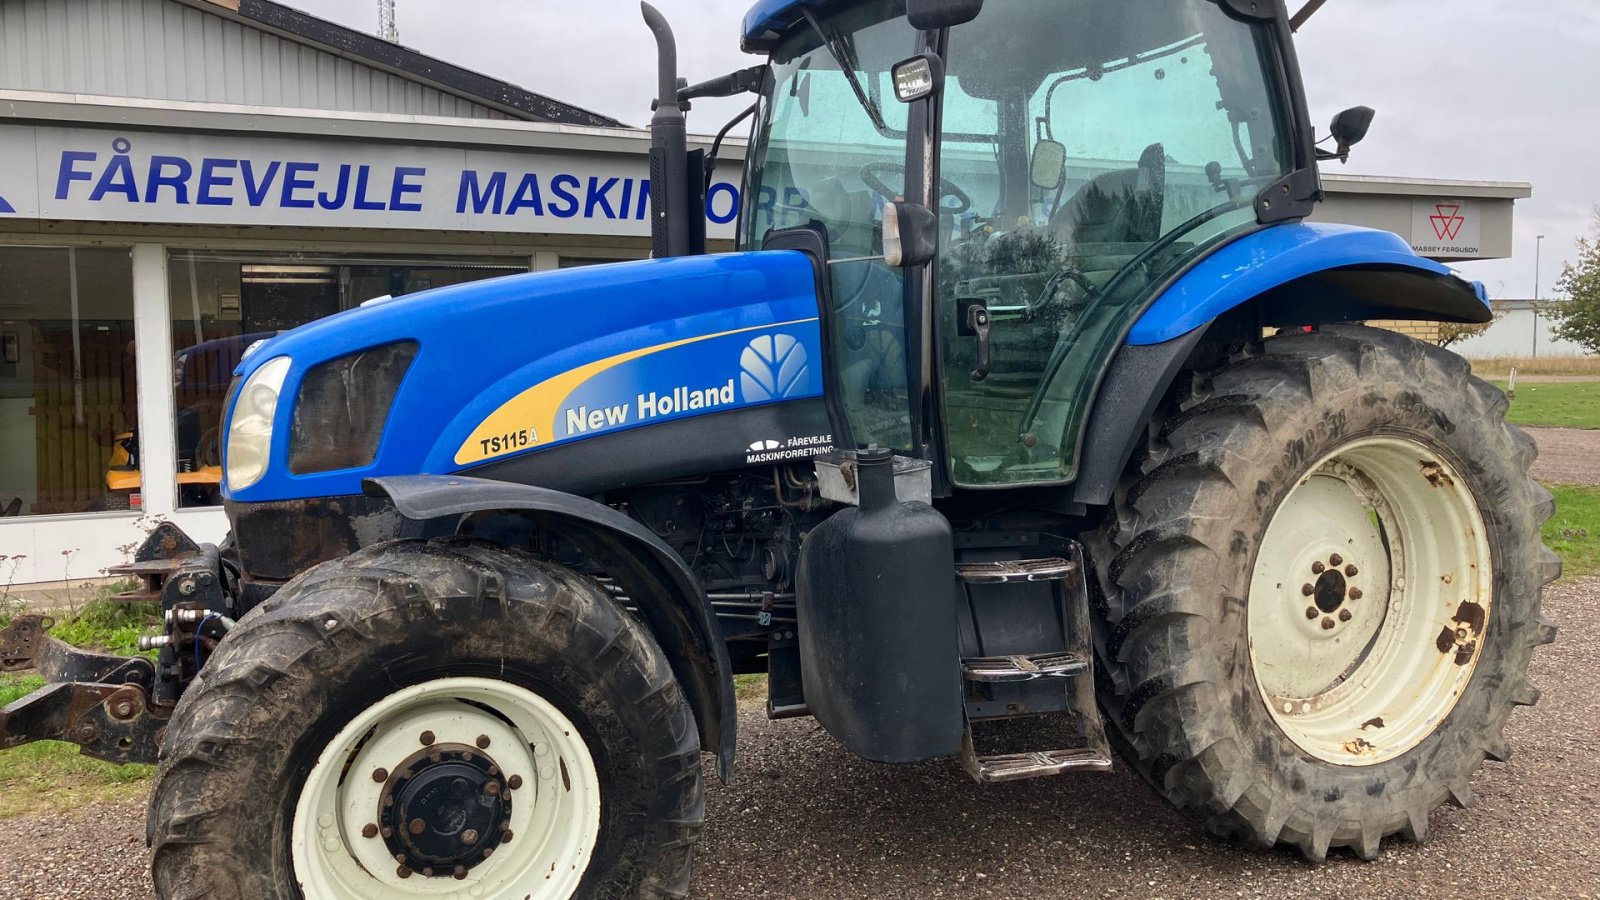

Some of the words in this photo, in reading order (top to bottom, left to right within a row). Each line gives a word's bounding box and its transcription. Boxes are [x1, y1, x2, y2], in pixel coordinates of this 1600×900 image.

[55, 137, 426, 212] FÅREVEJLE
[566, 404, 629, 435] New
[637, 379, 734, 420] Holland
[480, 427, 539, 455] TS115A
[787, 434, 832, 447] FÅREVEJLE
